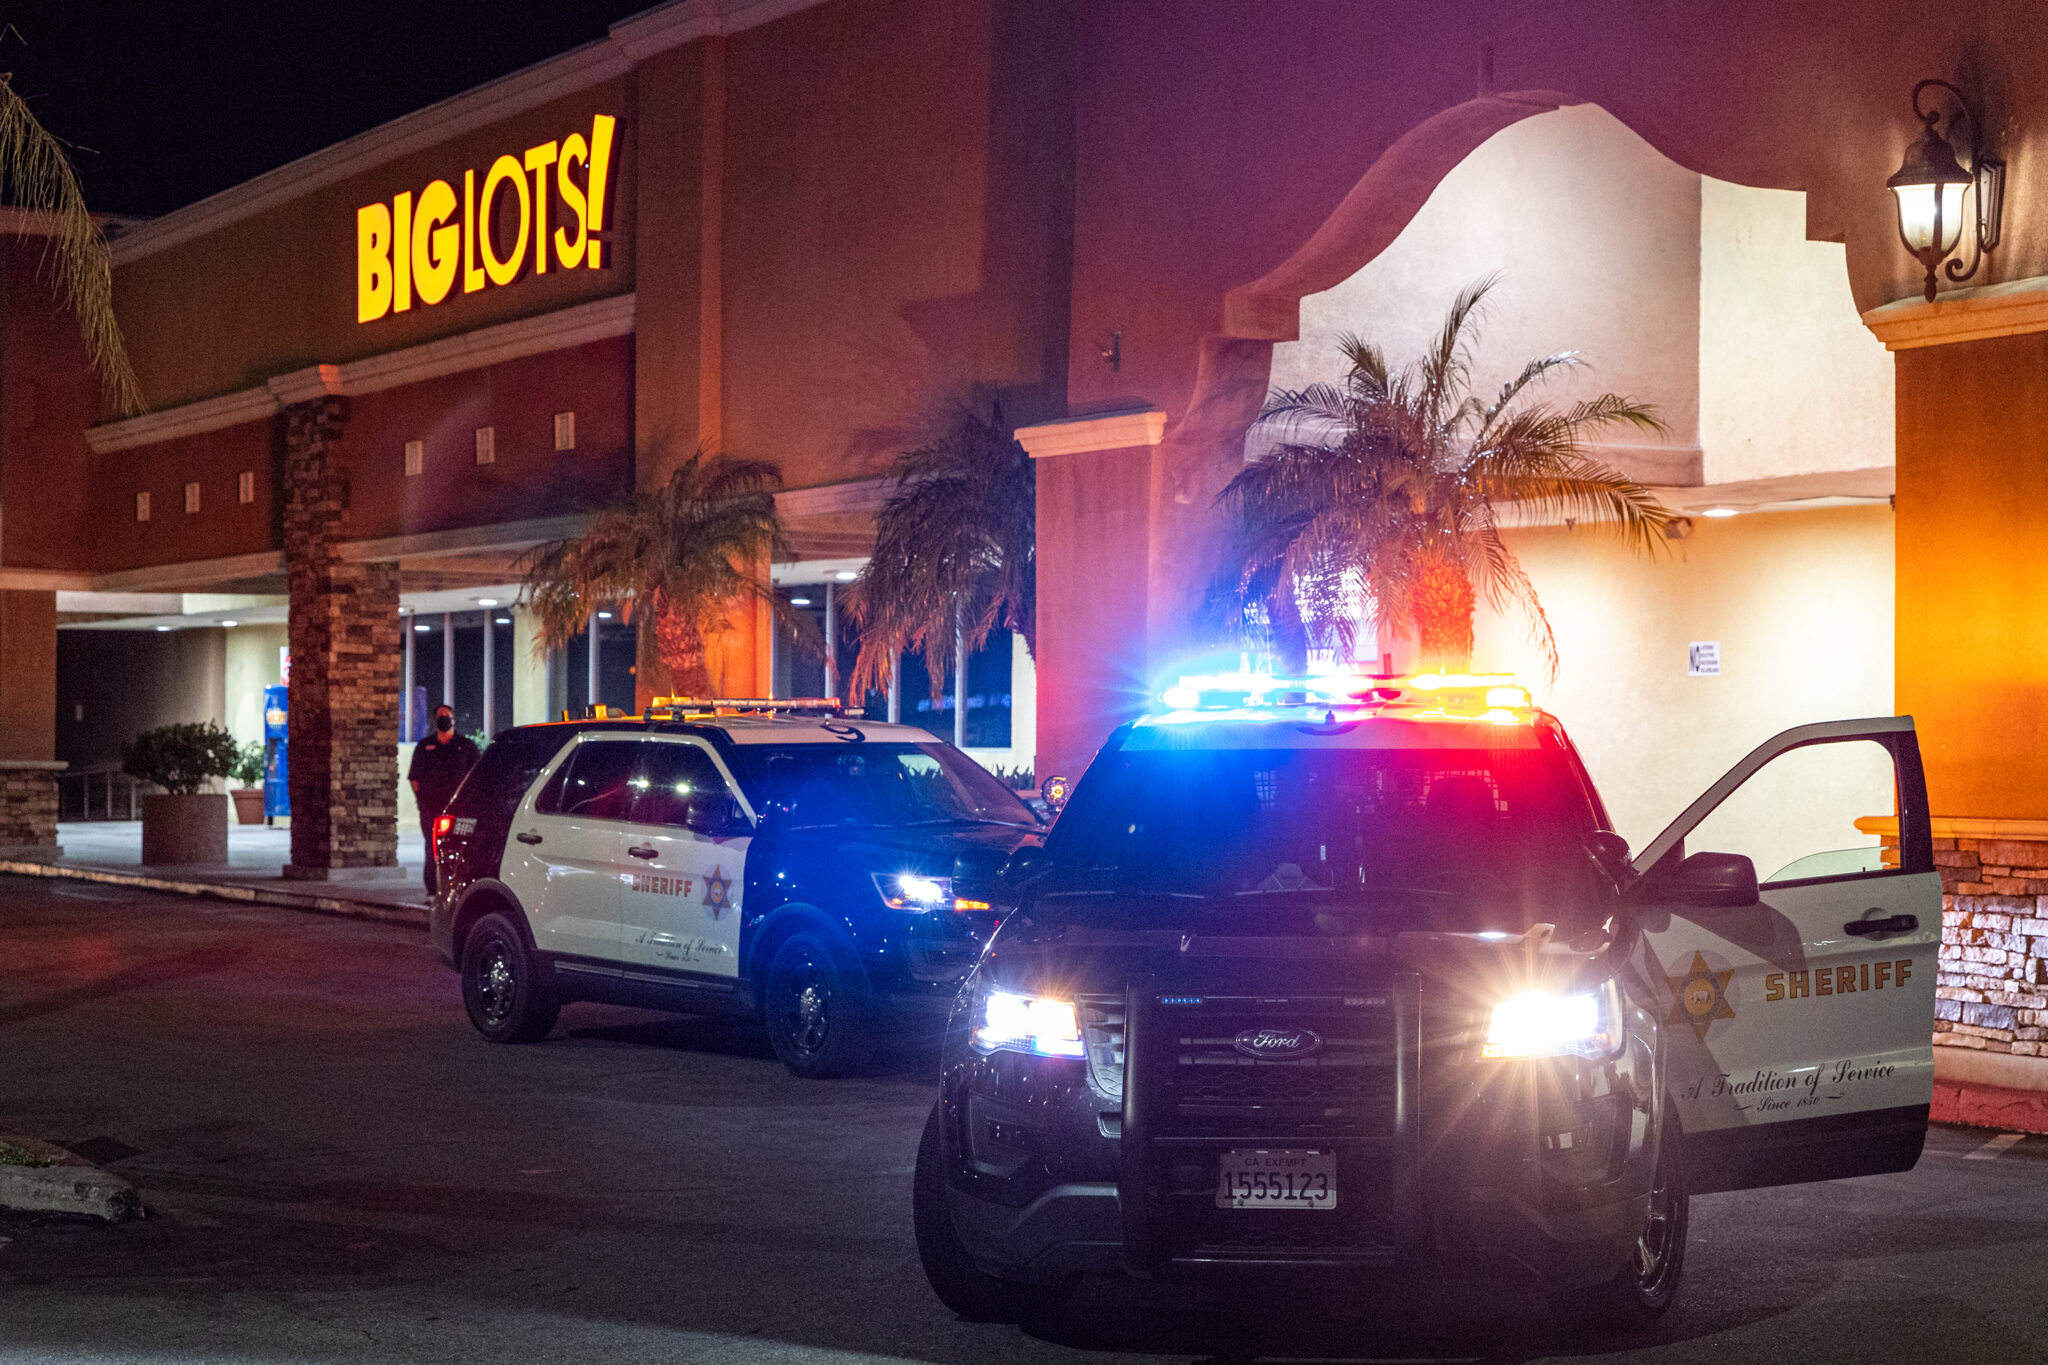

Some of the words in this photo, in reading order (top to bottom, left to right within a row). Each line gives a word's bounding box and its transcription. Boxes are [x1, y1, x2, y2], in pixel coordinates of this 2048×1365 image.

[632, 874, 692, 897] SHERIFF
[1765, 959, 1912, 1002] SHERIFF
[1253, 1029, 1301, 1048] Ford
[1681, 1077, 1705, 1099] A
[1711, 1071, 1796, 1097] Tradition
[1804, 1062, 1825, 1097] of
[1832, 1059, 1895, 1084] Service
[1756, 1096, 1791, 1112] Since
[1244, 1158, 1259, 1167] CA
[1265, 1158, 1306, 1167] EXEMPT
[1224, 1172, 1328, 1201] 1555123
